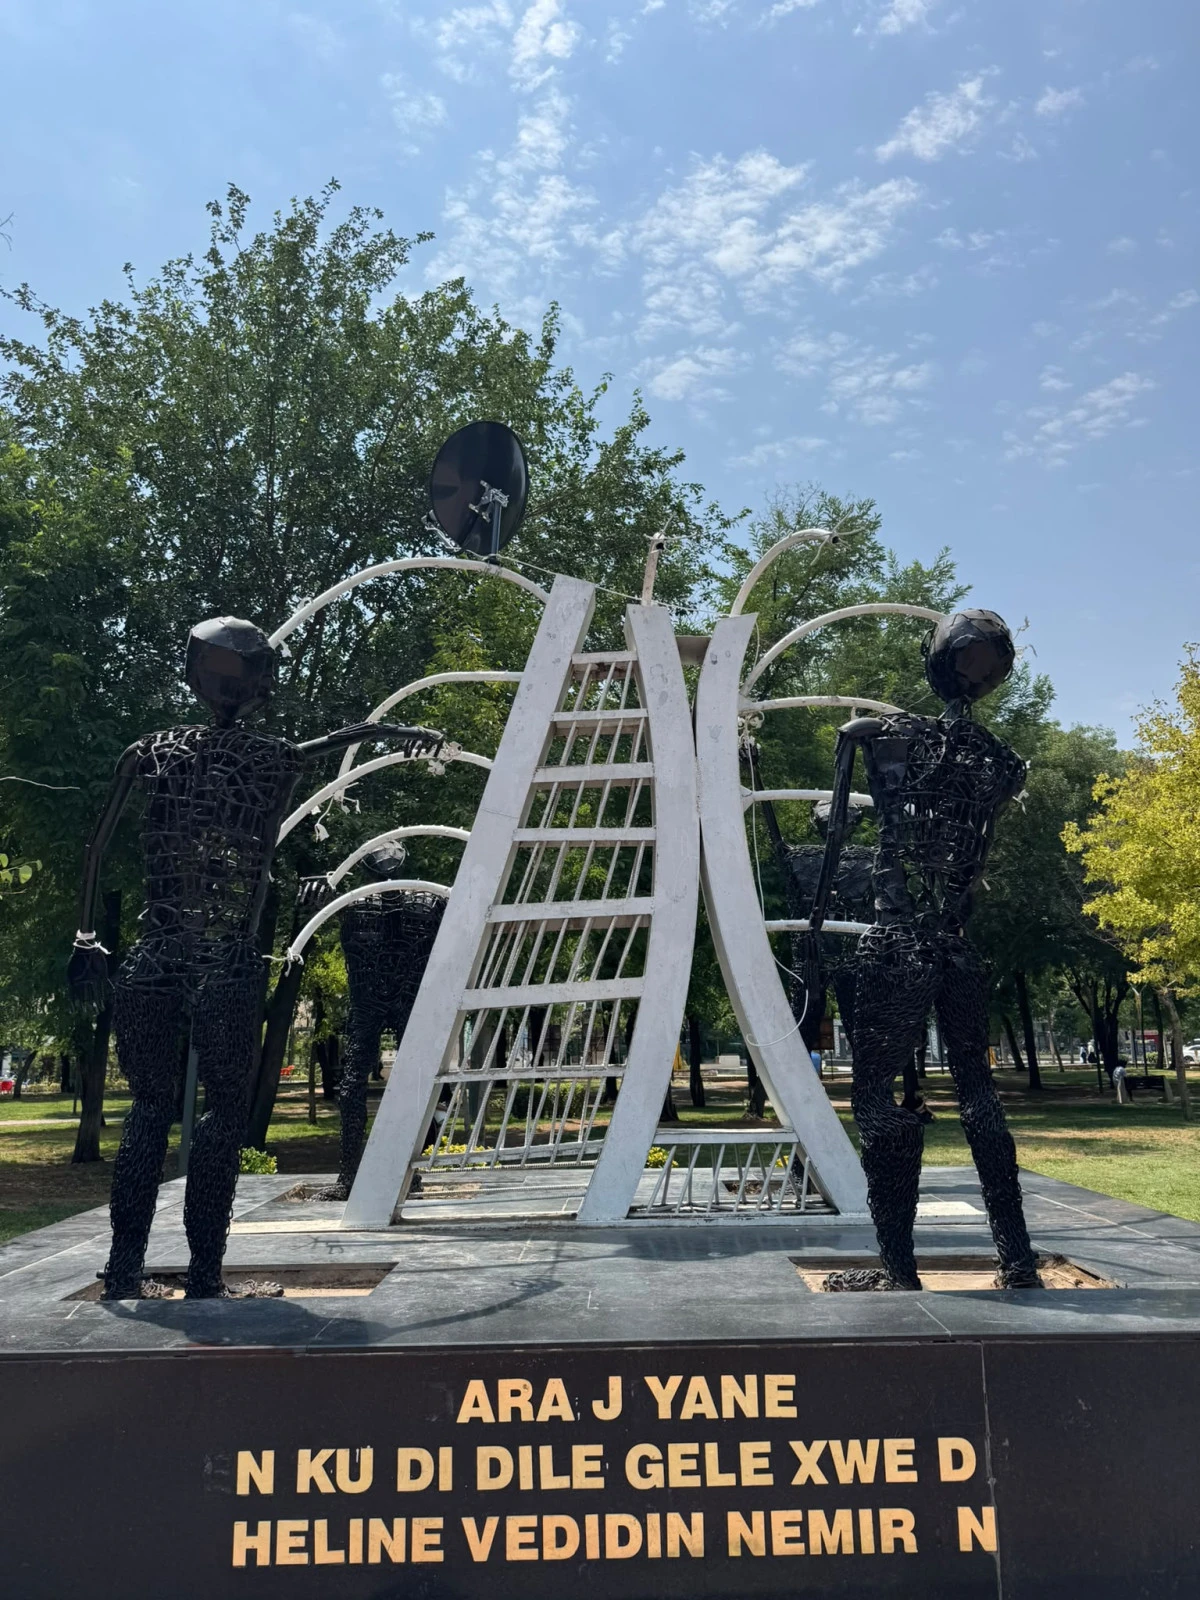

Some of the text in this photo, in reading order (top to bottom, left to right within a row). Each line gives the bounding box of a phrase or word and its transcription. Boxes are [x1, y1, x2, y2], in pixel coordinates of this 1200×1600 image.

[456, 1374, 798, 1423] ARA J YANE
[236, 1437, 977, 1495] N KU DI DILE GELE XWE D
[232, 1517, 444, 1567] HELINE
[461, 1512, 705, 1562] VEDIDIN
